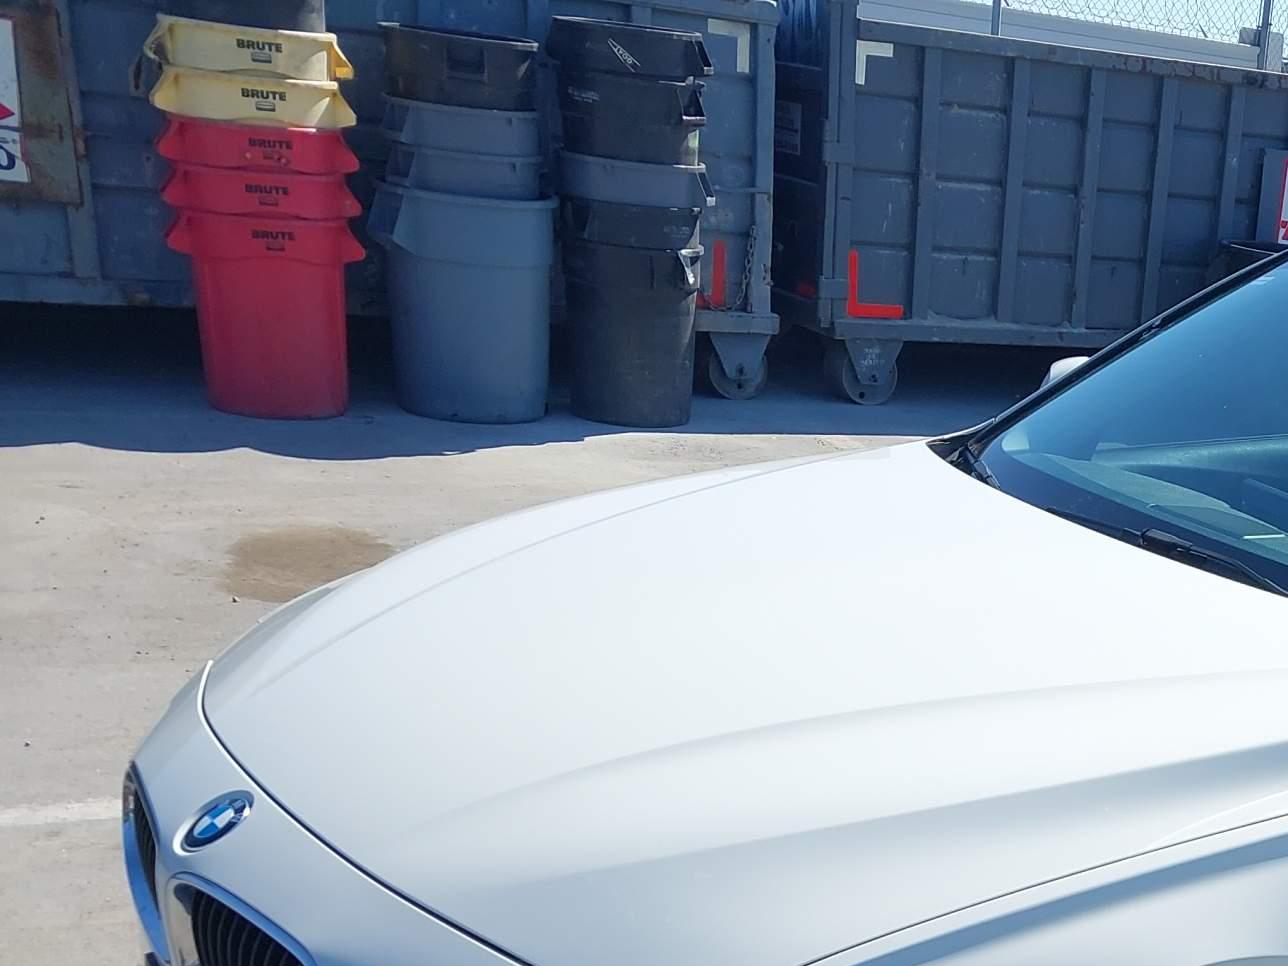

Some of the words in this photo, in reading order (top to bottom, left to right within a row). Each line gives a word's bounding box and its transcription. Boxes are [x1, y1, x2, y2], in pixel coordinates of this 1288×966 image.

[236, 38, 283, 53] BRUTE
[241, 87, 287, 101] BRUTE
[248, 137, 293, 150] BRUTE
[245, 183, 289, 195] BRUTE
[251, 229, 296, 241] BRUTE
